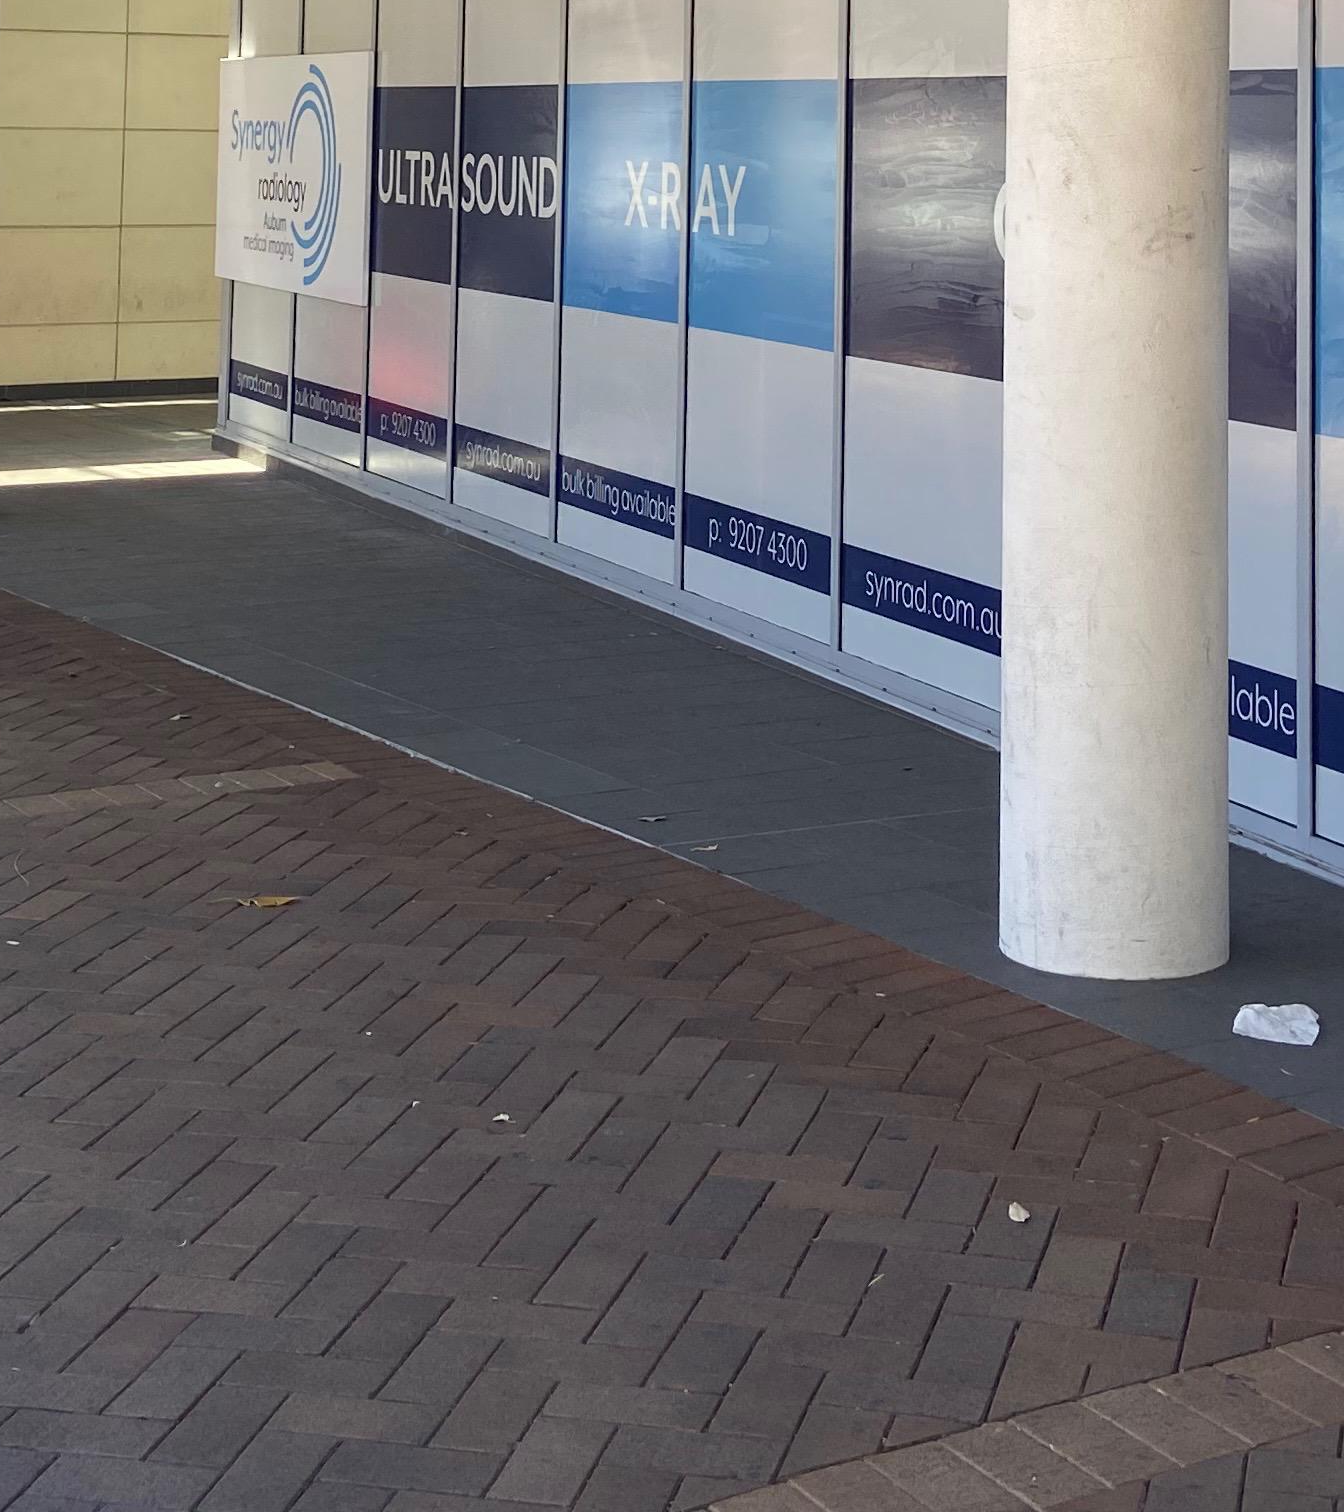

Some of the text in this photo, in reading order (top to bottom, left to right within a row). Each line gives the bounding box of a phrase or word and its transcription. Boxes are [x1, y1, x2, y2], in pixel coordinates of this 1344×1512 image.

[231, 109, 285, 164] Synergy
[258, 172, 306, 212] radiology
[378, 150, 558, 219] ULTRASOUND
[624, 160, 747, 236] X-RAY
[391, 411, 412, 437] 9207
[413, 417, 436, 447] 4300
[465, 441, 541, 481] synrad.com.au
[562, 465, 676, 526] bulk billing available
[708, 516, 808, 572] p: 9207 4300
[864, 568, 1003, 639] synrad.com.au
[1231, 674, 1296, 736] lable
